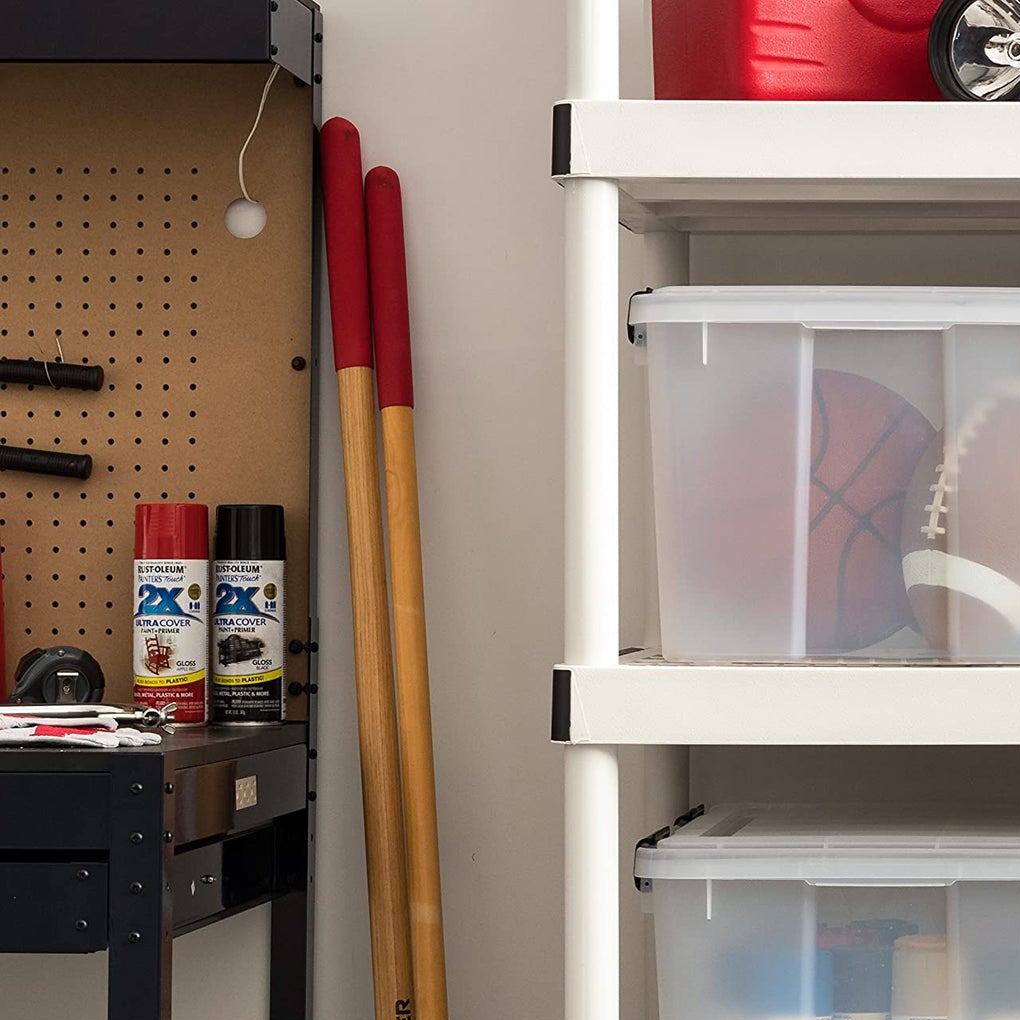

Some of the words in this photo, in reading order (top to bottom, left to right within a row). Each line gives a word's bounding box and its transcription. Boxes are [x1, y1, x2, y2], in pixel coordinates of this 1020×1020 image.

[138, 583, 185, 614] 2X
[215, 583, 260, 614] 2X
[160, 619, 191, 627] COVER
[235, 618, 266, 626] COVER
